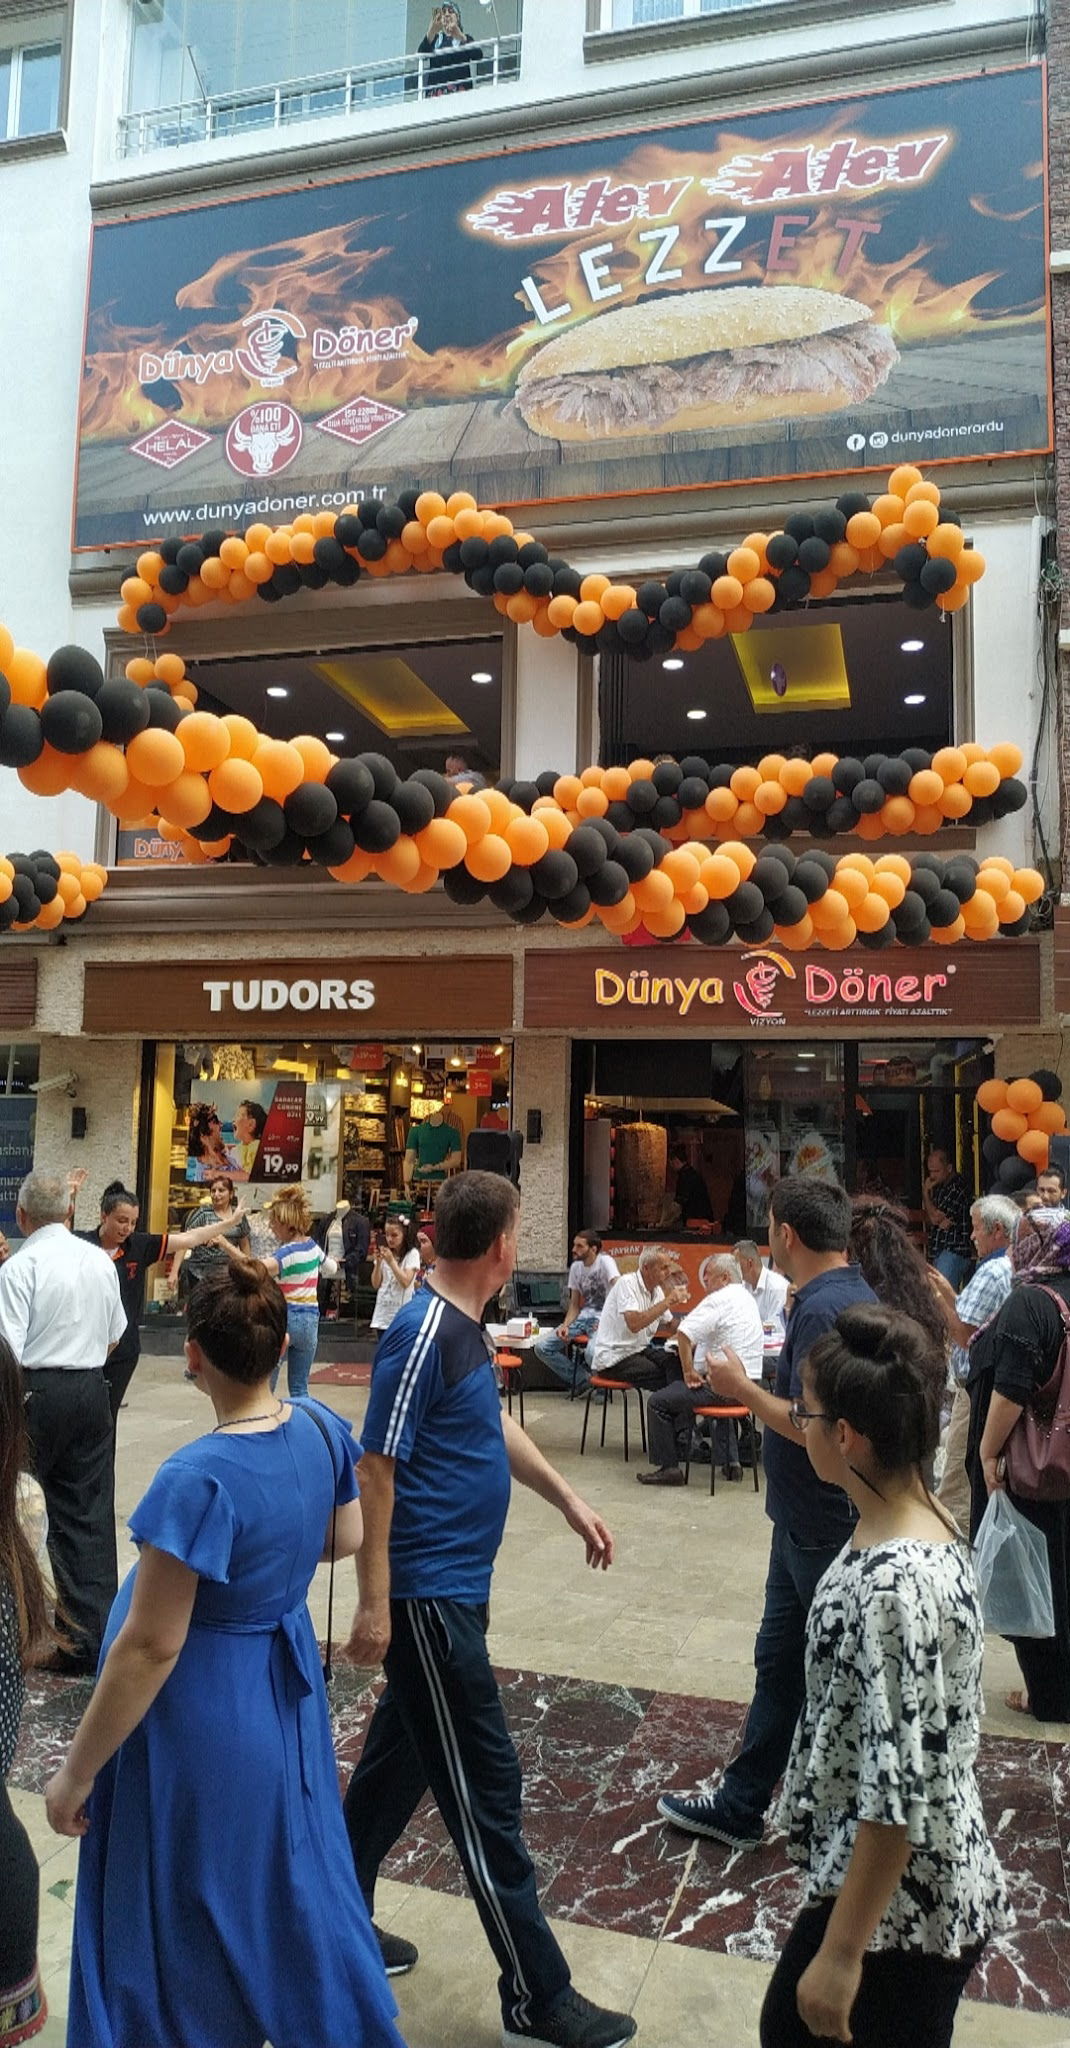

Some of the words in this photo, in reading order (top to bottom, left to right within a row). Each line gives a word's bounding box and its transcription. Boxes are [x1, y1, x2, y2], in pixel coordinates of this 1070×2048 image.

[466, 177, 693, 239] Alev
[700, 135, 947, 205] Alev
[521, 215, 882, 325] LEZZET
[139, 350, 234, 384] Dünya
[313, 322, 412, 359] Döner
[250, 407, 281, 424] %100
[146, 438, 195, 453] HELAL
[892, 421, 1004, 443] dunyadonerordu
[134, 838, 181, 862] Düny
[202, 979, 375, 1012] TUDORS
[594, 968, 724, 1015] Dünya
[805, 964, 947, 1002] Döner
[263, 1154, 299, 1174] 19,99
